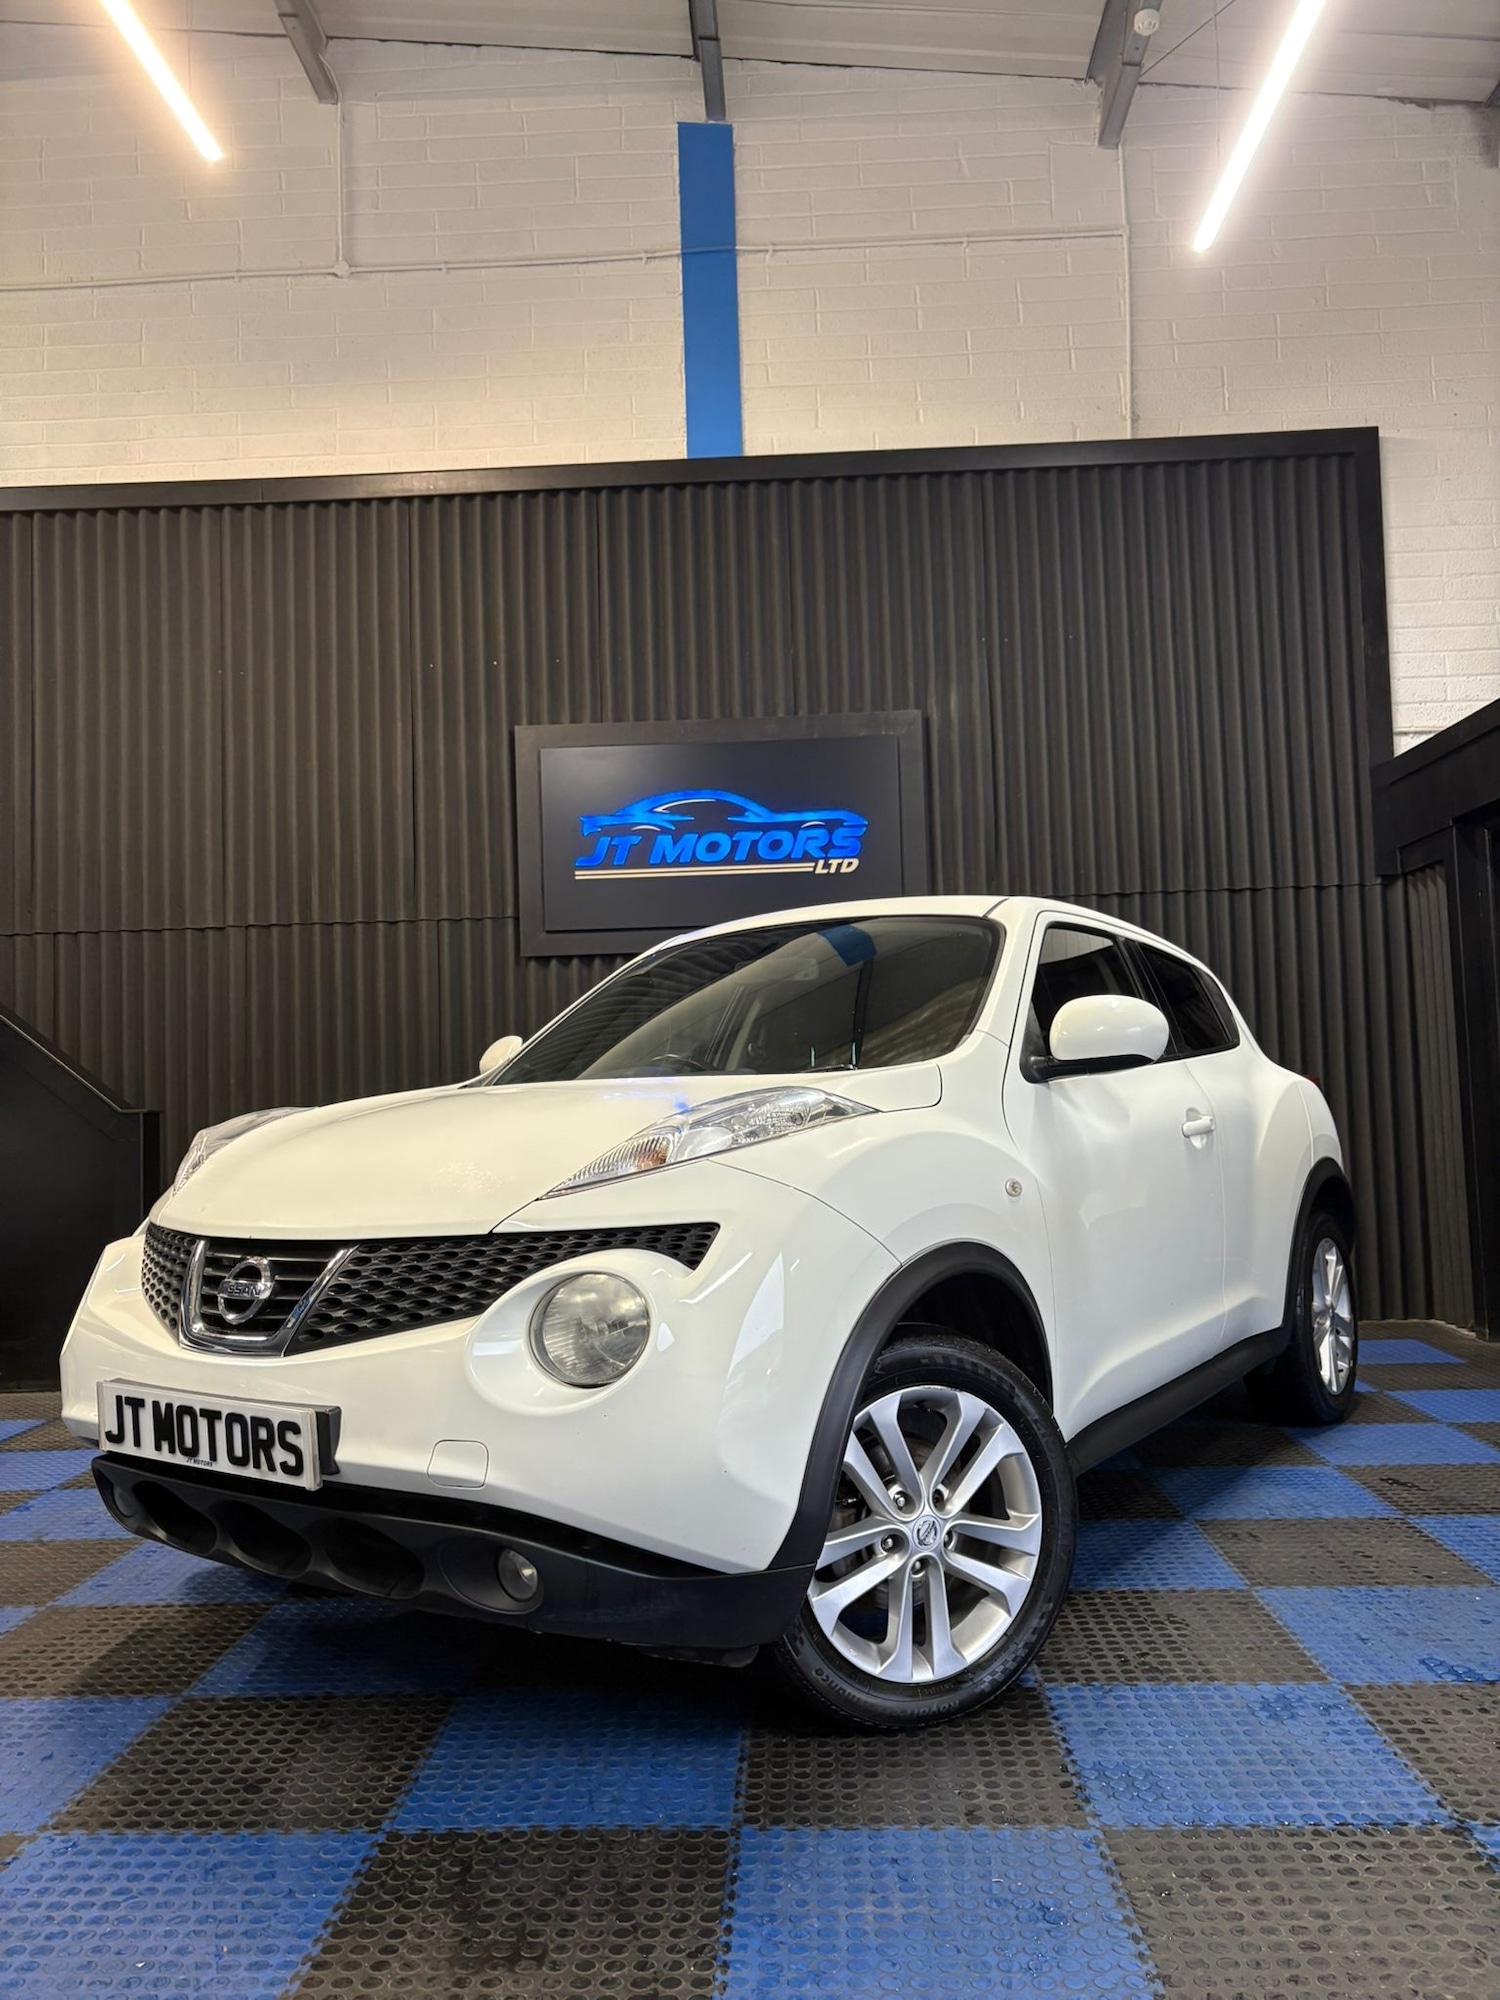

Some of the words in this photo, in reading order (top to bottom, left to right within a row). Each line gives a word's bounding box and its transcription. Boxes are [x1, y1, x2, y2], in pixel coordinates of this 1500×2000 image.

[574, 836, 642, 866] JT
[649, 827, 867, 865] MOTORS
[814, 858, 860, 874] LTD
[223, 1283, 262, 1298] SSAN
[105, 1395, 145, 1448] JT
[152, 1400, 304, 1476] MOTORS
[193, 1458, 213, 1467] MOTORS
